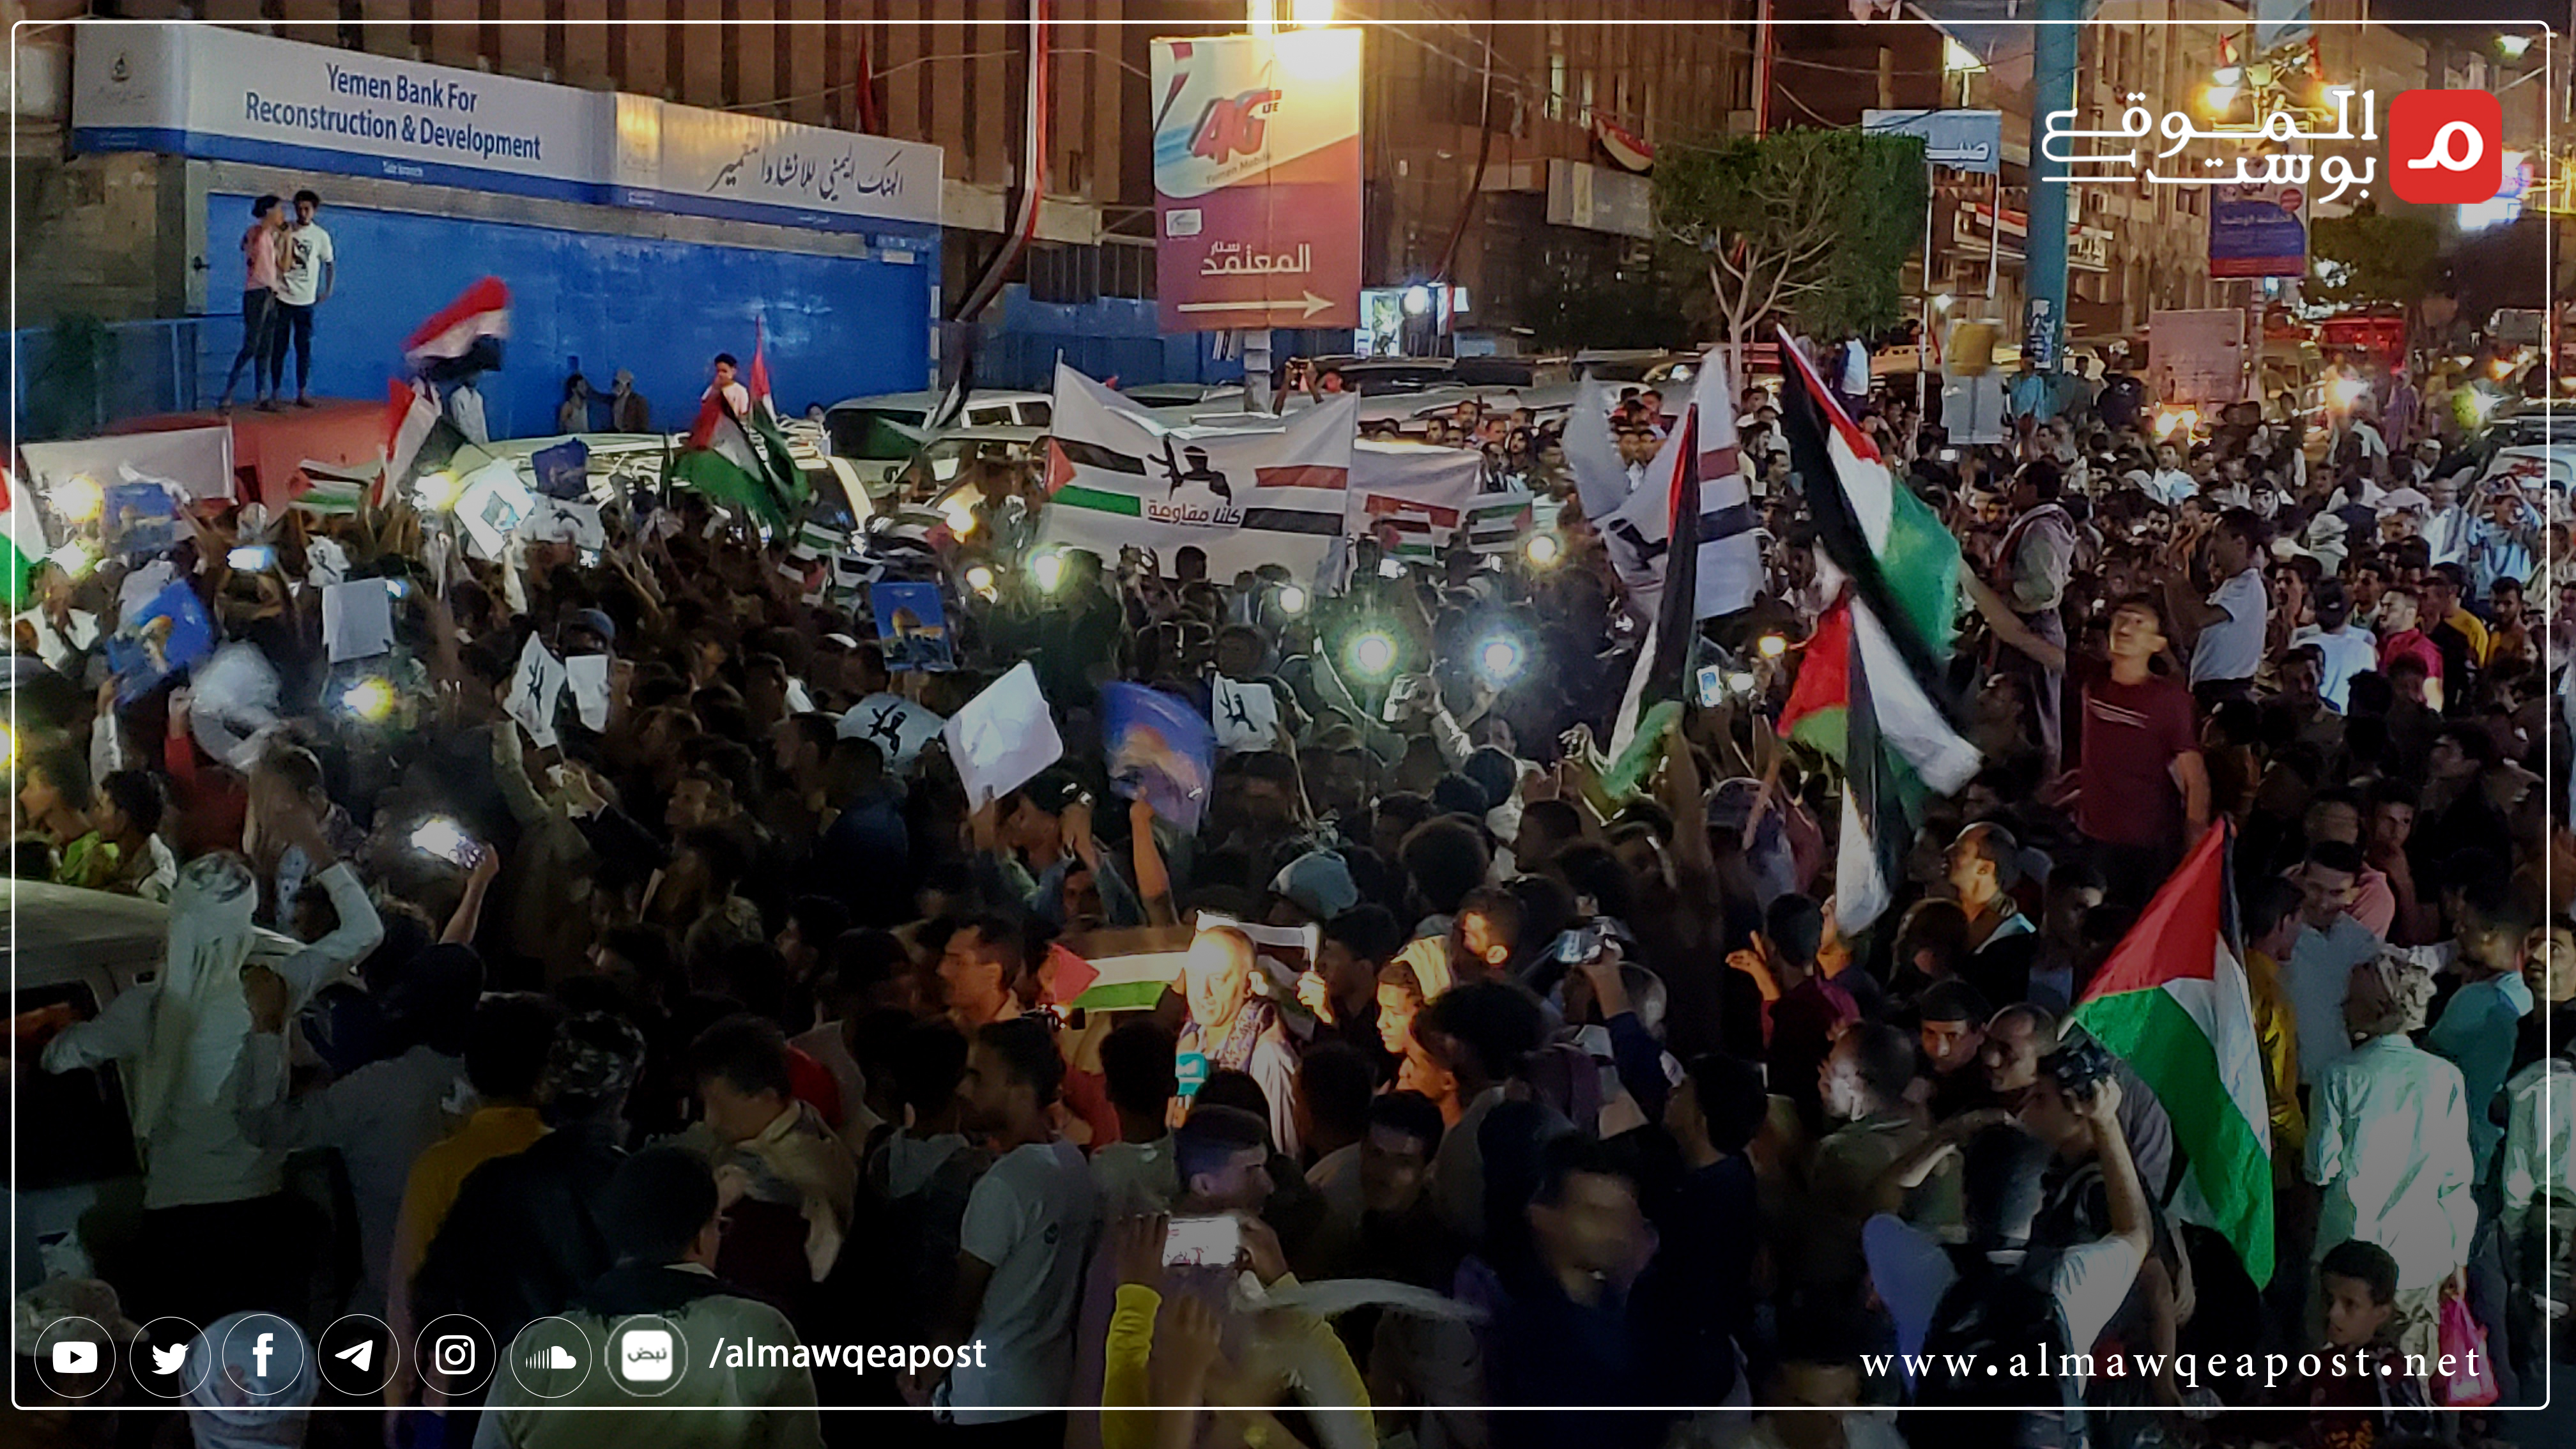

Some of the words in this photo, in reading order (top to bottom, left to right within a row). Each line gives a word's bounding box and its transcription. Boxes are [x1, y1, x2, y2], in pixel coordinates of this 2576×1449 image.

[326, 63, 391, 100] Yemen
[396, 74, 443, 108] Bank
[448, 83, 479, 112] For
[245, 91, 397, 141] Reconstruction
[401, 114, 415, 142] &
[420, 116, 542, 160] Development
[1187, 88, 1282, 165] 4G
[1199, 243, 1311, 275] المعتمد
[1148, 500, 1209, 525] مقاومة
[1213, 507, 1241, 525] كلنا
